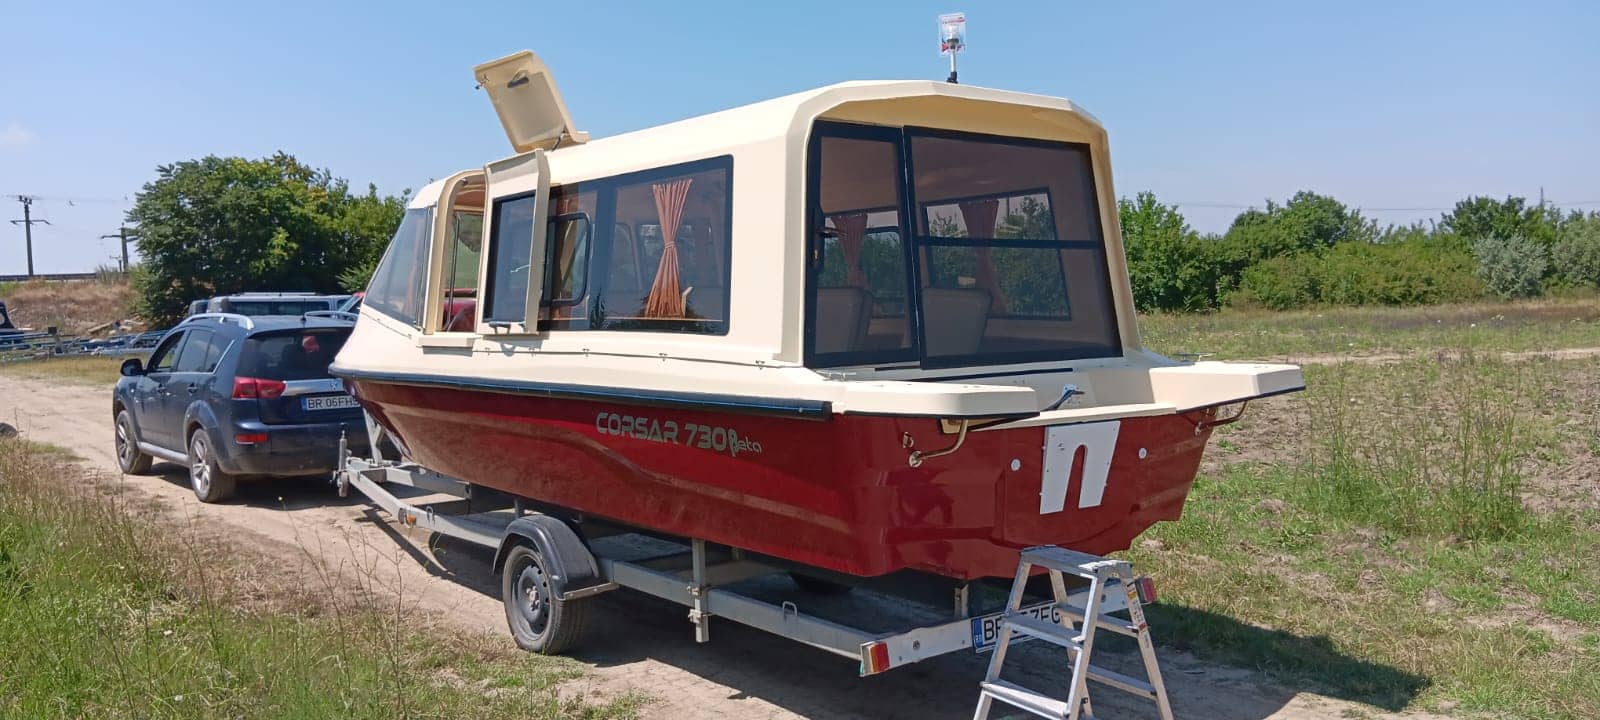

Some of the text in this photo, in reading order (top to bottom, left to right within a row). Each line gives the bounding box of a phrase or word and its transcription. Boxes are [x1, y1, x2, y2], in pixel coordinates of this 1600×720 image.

[308, 398, 323, 409] BR
[596, 412, 679, 445] CORSAR
[684, 423, 727, 451] 730
